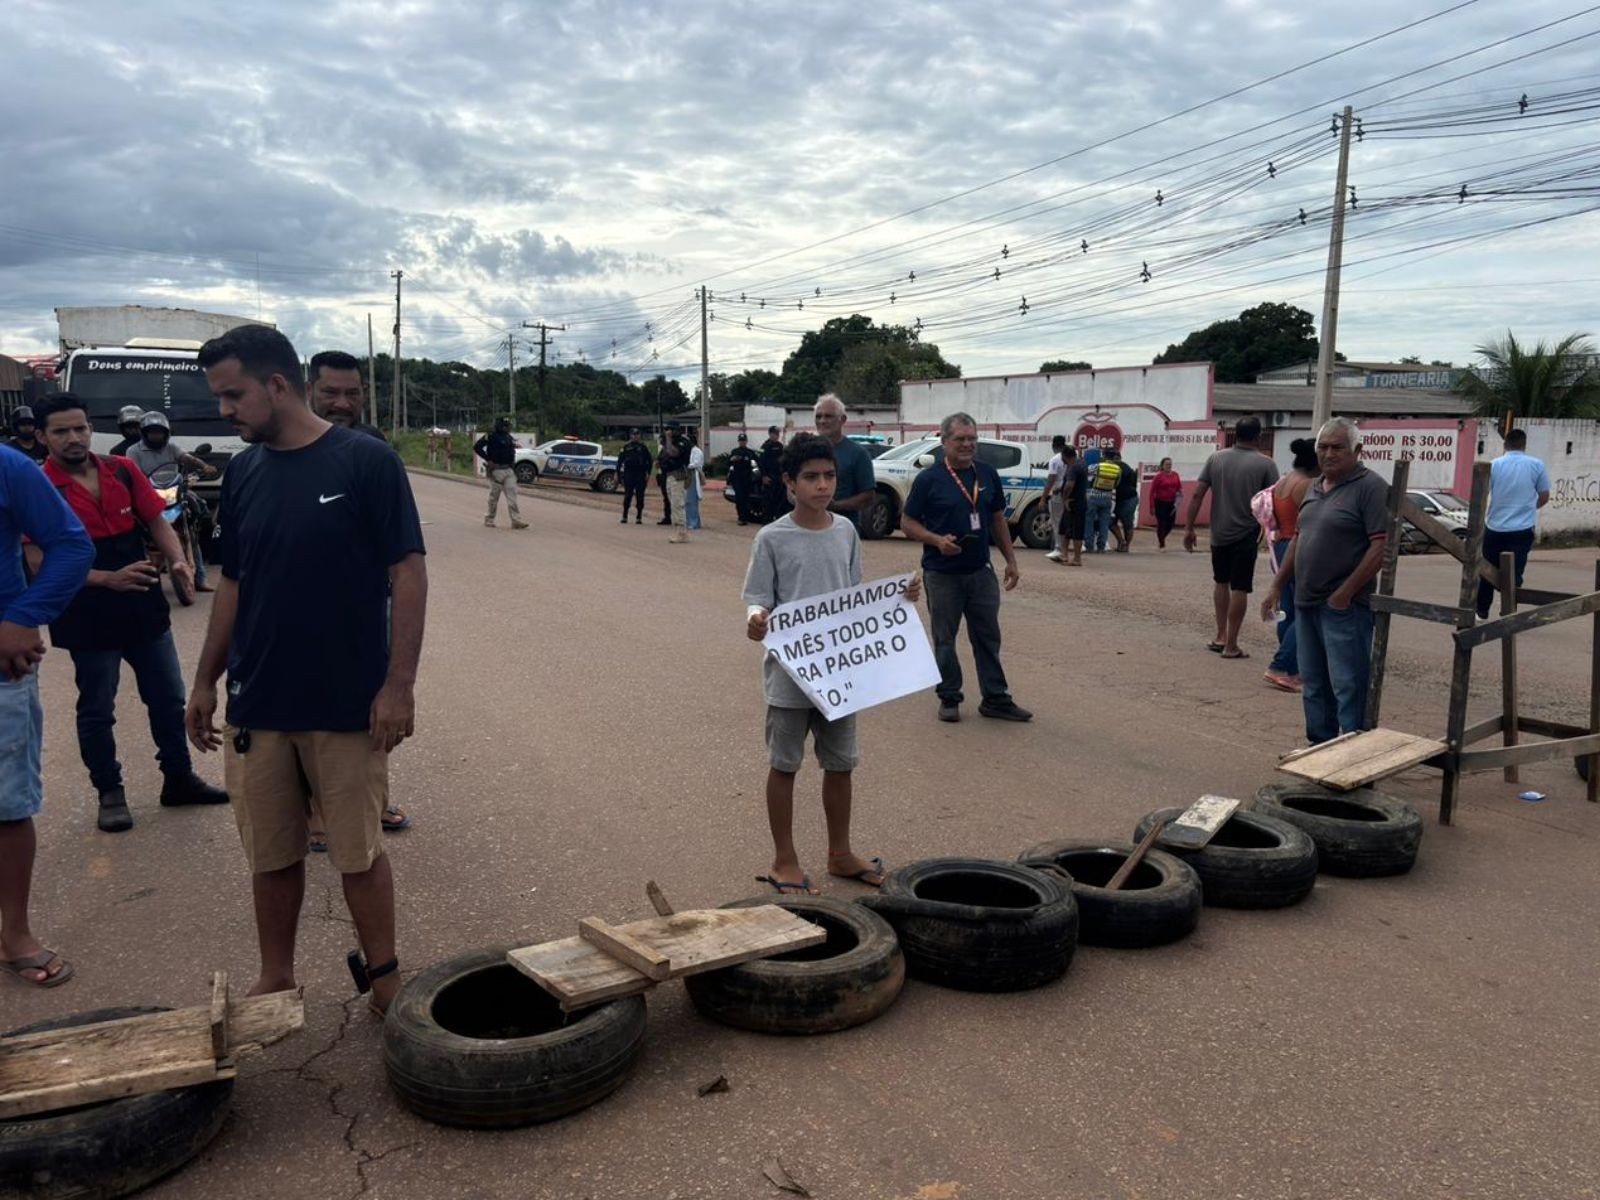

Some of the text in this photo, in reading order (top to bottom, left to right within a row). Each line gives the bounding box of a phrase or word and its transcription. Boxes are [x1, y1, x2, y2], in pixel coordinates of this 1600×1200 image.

[88, 360, 122, 370] Deus
[1372, 371, 1449, 388] TORNEARIA
[1079, 434, 1115, 448] Belles
[1402, 434, 1416, 447] R$
[1419, 435, 1453, 447] 30,00
[1401, 449, 1415, 461] R$
[1418, 450, 1452, 461] 40,00
[768, 578, 908, 633] TRABALHAMOS
[783, 632, 825, 661] MÊS
[827, 616, 879, 648] TODO
[882, 603, 908, 629] SÓ
[825, 640, 888, 675] PAGAR
[891, 634, 907, 652] O
